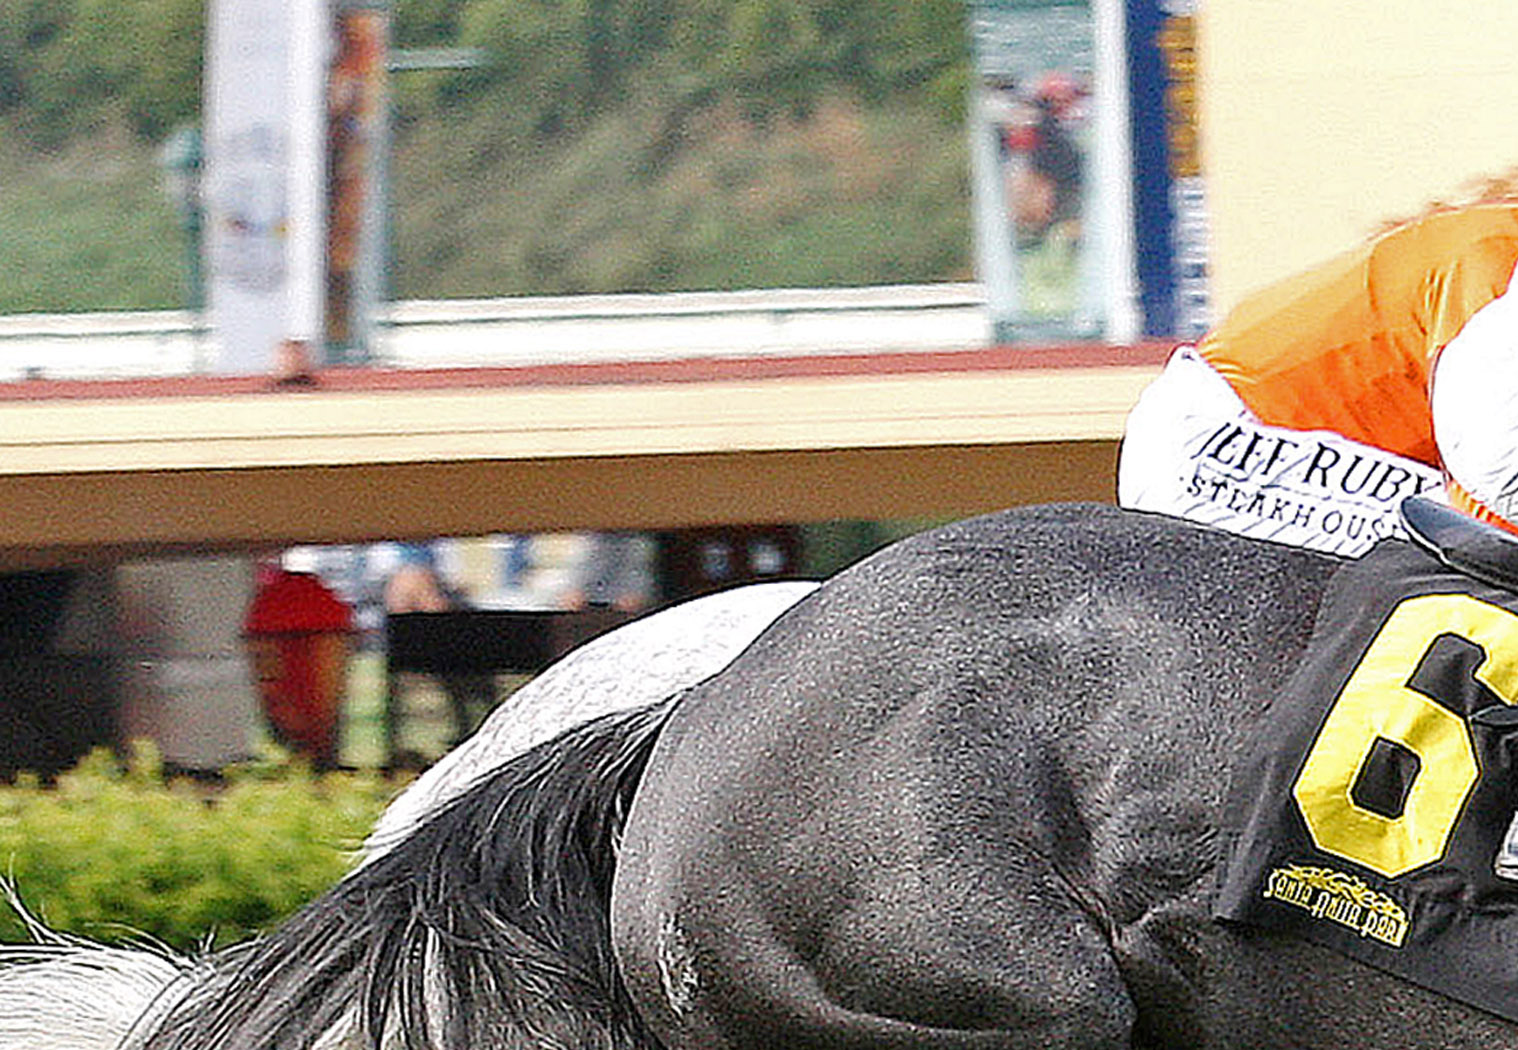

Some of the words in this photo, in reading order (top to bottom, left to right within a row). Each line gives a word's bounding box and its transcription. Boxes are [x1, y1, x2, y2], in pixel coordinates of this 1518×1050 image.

[1187, 474, 1402, 541] STEAKHOUS
[1263, 872, 1312, 909] SANTA
[1311, 891, 1362, 931] ANITA
